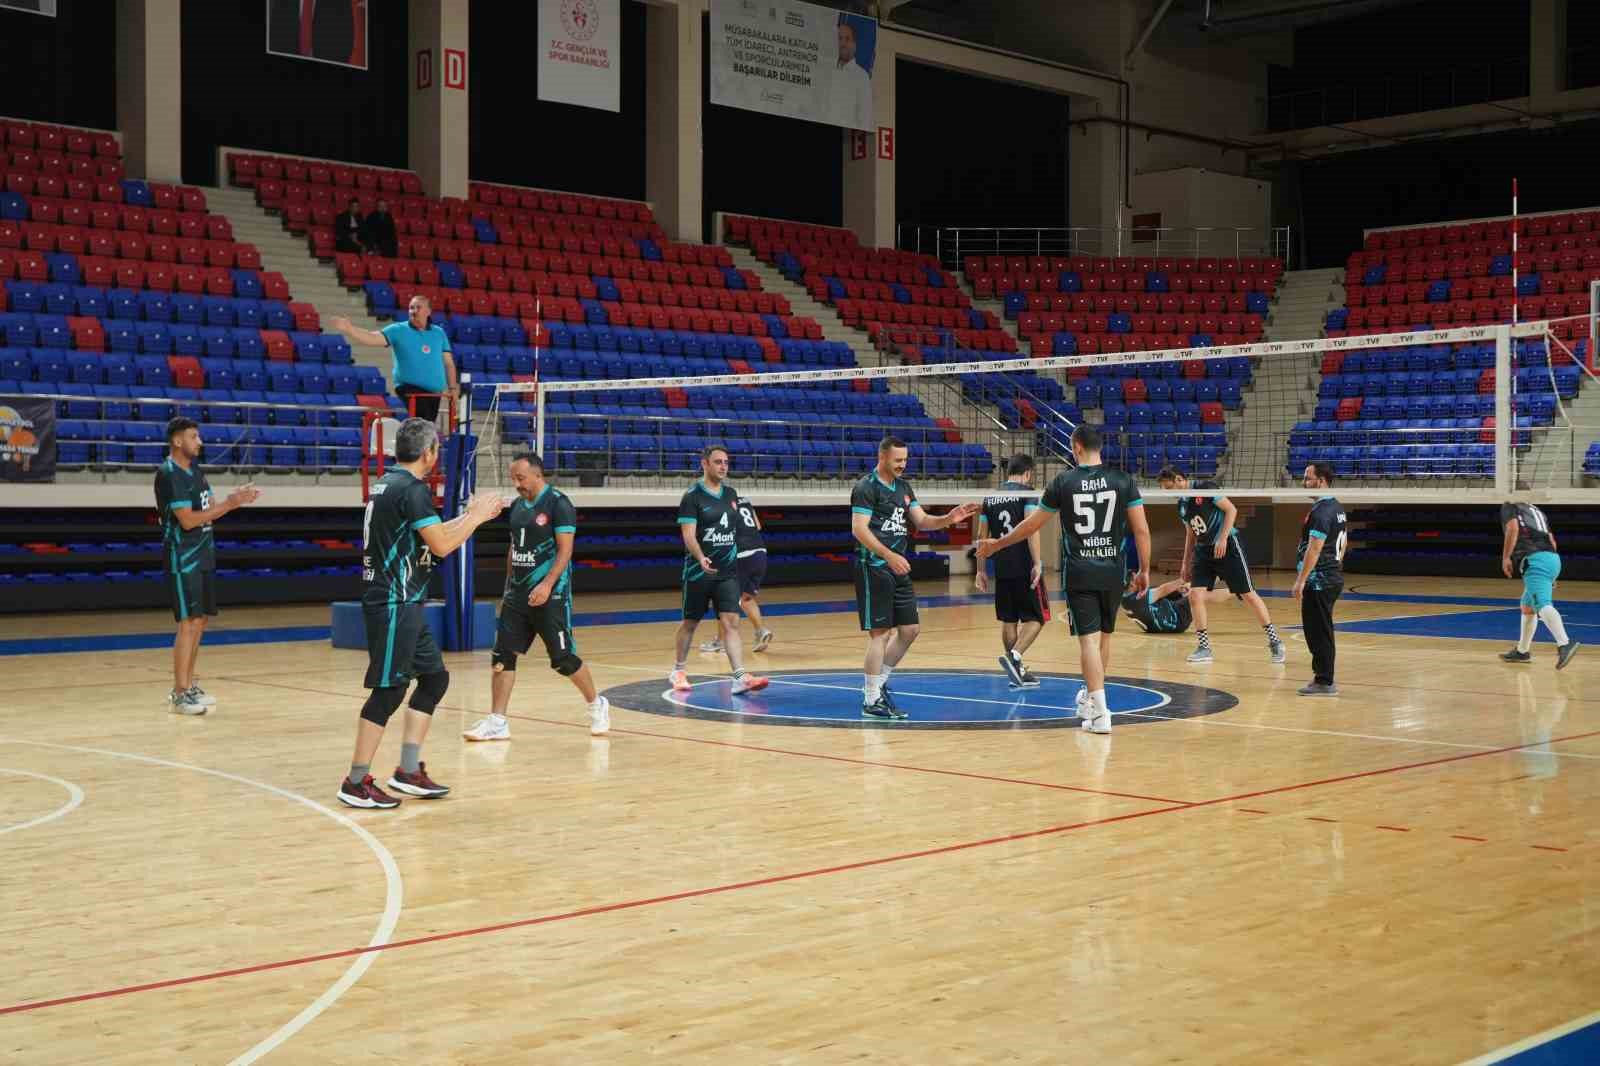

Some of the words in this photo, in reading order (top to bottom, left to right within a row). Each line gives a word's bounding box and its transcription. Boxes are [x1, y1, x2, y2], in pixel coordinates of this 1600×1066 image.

[448, 53, 462, 85] D
[880, 130, 890, 157] E
[1366, 337, 1381, 345] TVF
[1400, 335, 1414, 343] TVF
[1434, 332, 1449, 340] TVF
[1081, 477, 1107, 491] BAHA
[719, 511, 729, 528] 4
[739, 507, 756, 527] 8
[1072, 490, 1117, 535] 57
[998, 510, 1015, 537] 3
[519, 527, 526, 547] 1
[1083, 535, 1113, 547] NİĞDE
[1079, 545, 1118, 558] VALİLİĞİ
[558, 631, 566, 650] 1
